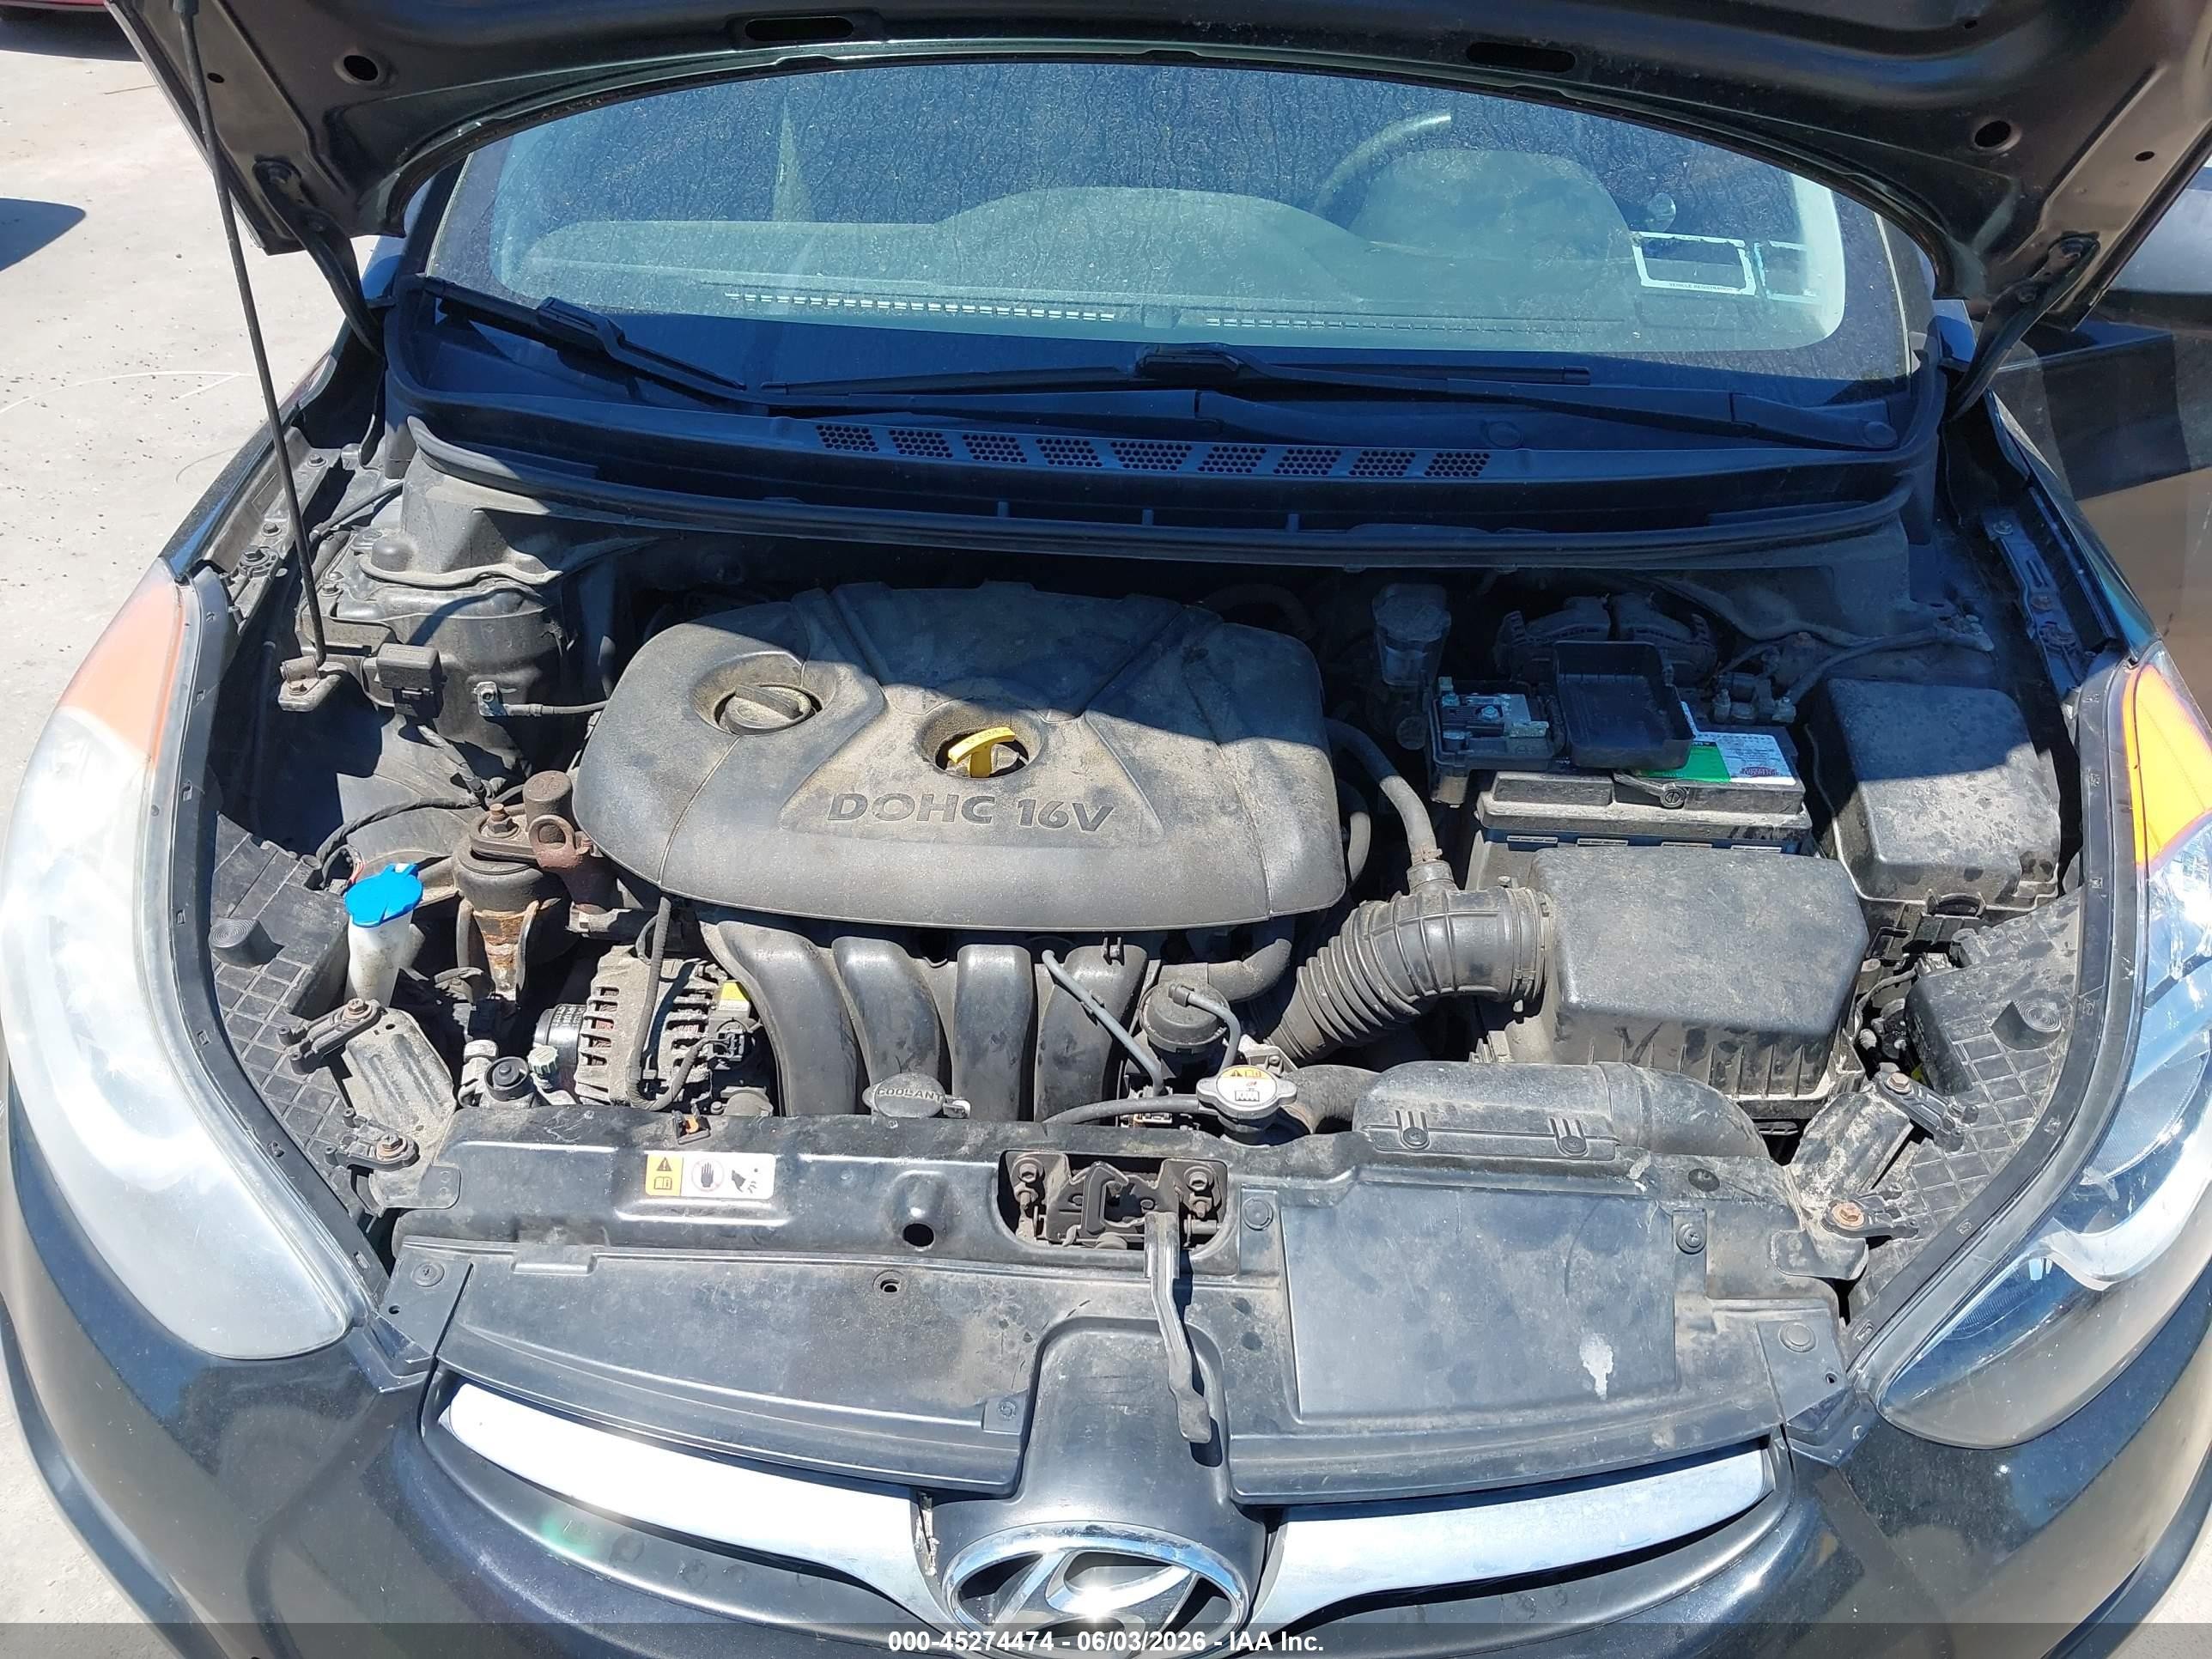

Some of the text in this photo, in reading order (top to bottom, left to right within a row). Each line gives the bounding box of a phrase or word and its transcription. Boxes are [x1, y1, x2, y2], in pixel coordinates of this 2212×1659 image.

[827, 793, 1115, 832] DOHC 16V
[877, 1088, 944, 1103] COOLANT
